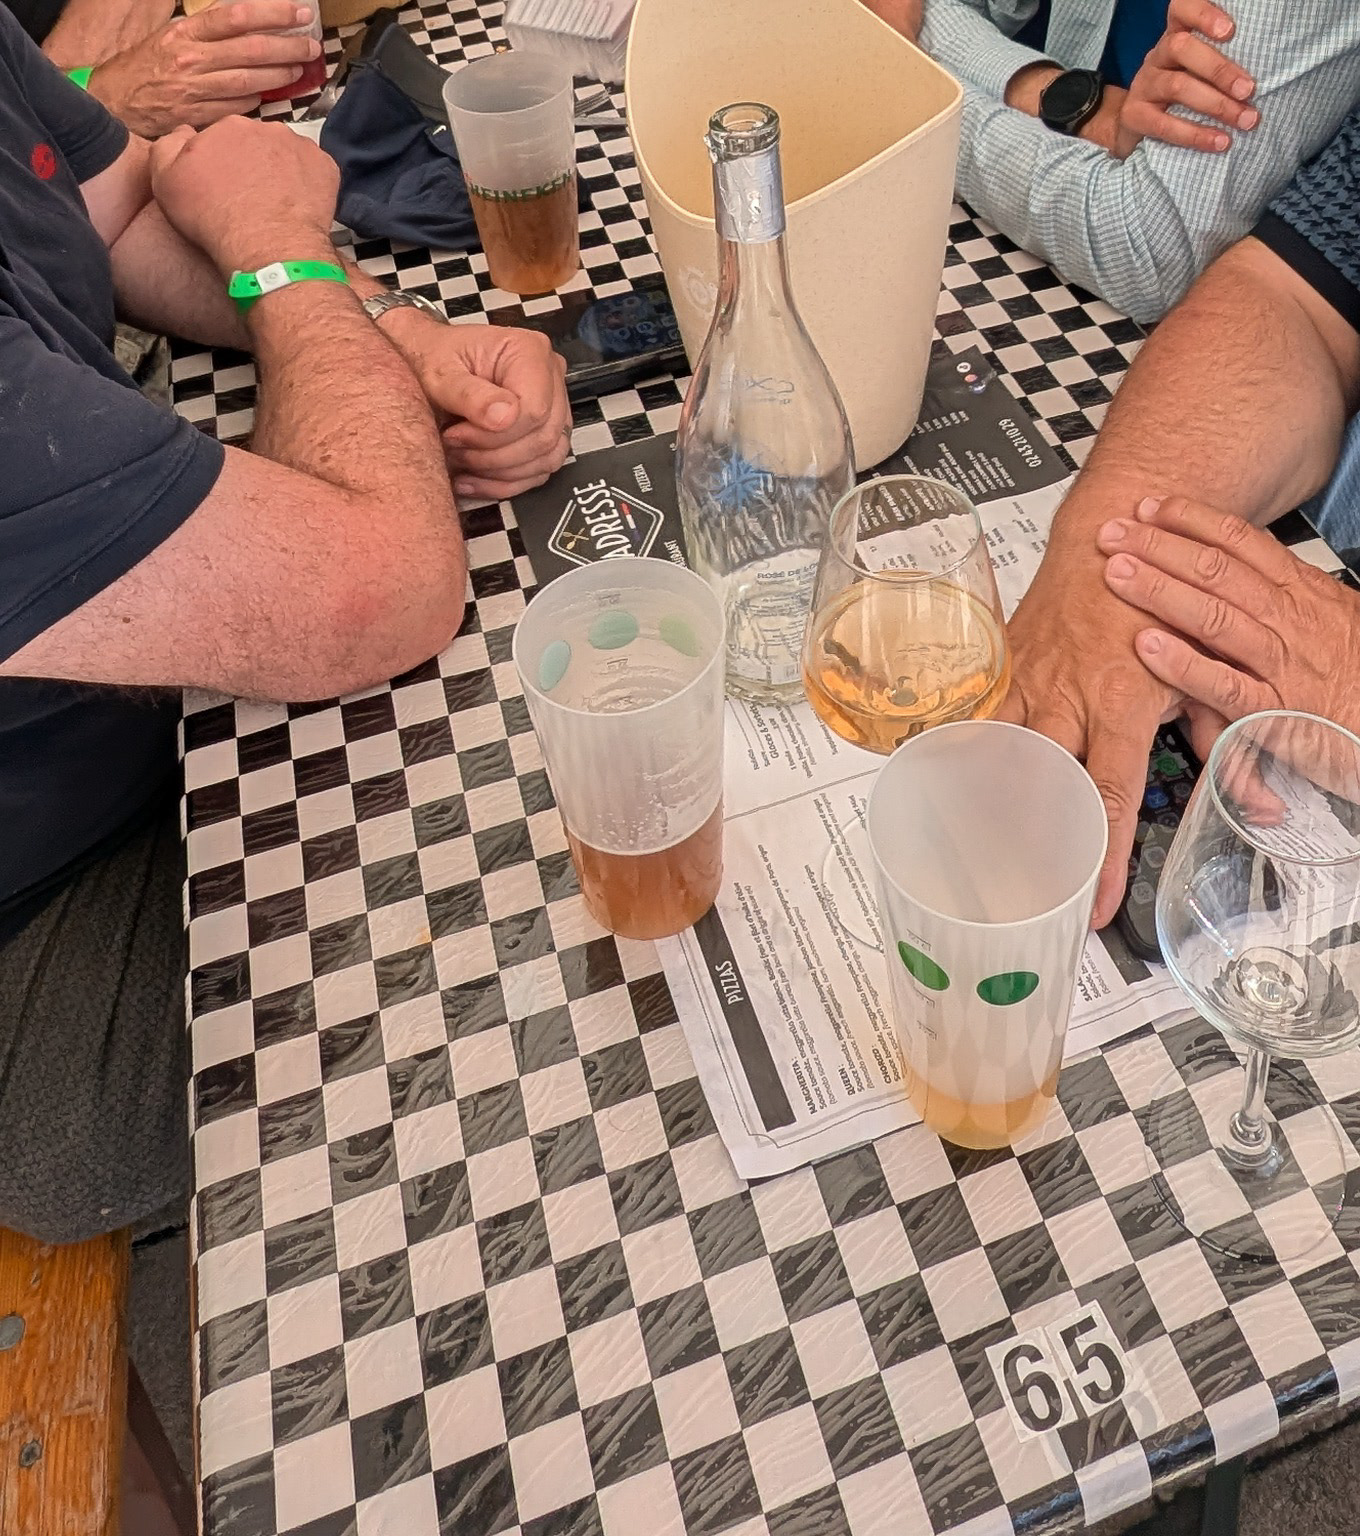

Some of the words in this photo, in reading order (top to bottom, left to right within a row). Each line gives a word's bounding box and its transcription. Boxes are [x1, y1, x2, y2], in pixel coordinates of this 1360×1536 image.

[998, 418, 1014, 429] 29
[1005, 427, 1020, 438] 10
[1012, 435, 1027, 446] 21
[1017, 444, 1033, 456] 43
[1025, 454, 1041, 467] 02
[633, 463, 652, 492] PIZZERIA
[764, 733, 779, 758] Glaces
[715, 960, 743, 1003] PIZZAS
[872, 1048, 891, 1083] CHORIZO
[792, 1060, 817, 1114] MARGHERITA
[814, 1086, 827, 1109] Sauce
